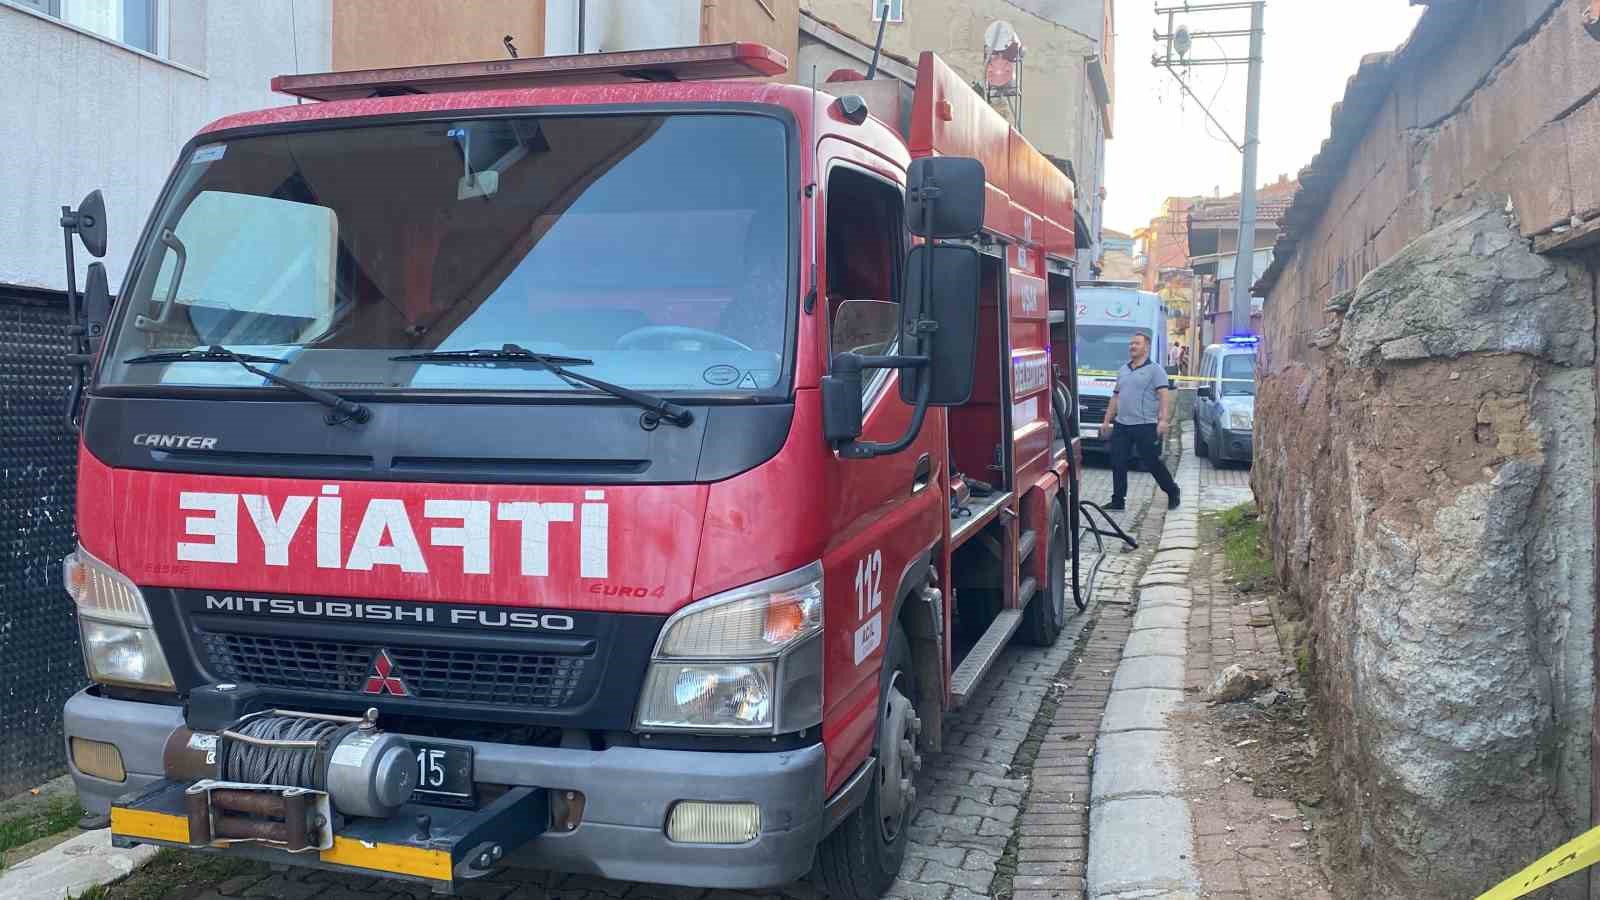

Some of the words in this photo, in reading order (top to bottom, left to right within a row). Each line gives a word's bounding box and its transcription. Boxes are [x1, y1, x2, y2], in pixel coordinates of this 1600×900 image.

[133, 433, 218, 449] CANTER
[855, 549, 882, 620] 112
[206, 595, 434, 622] MITSUBISHI
[450, 609, 574, 630] FUSO
[417, 748, 446, 786] 15
